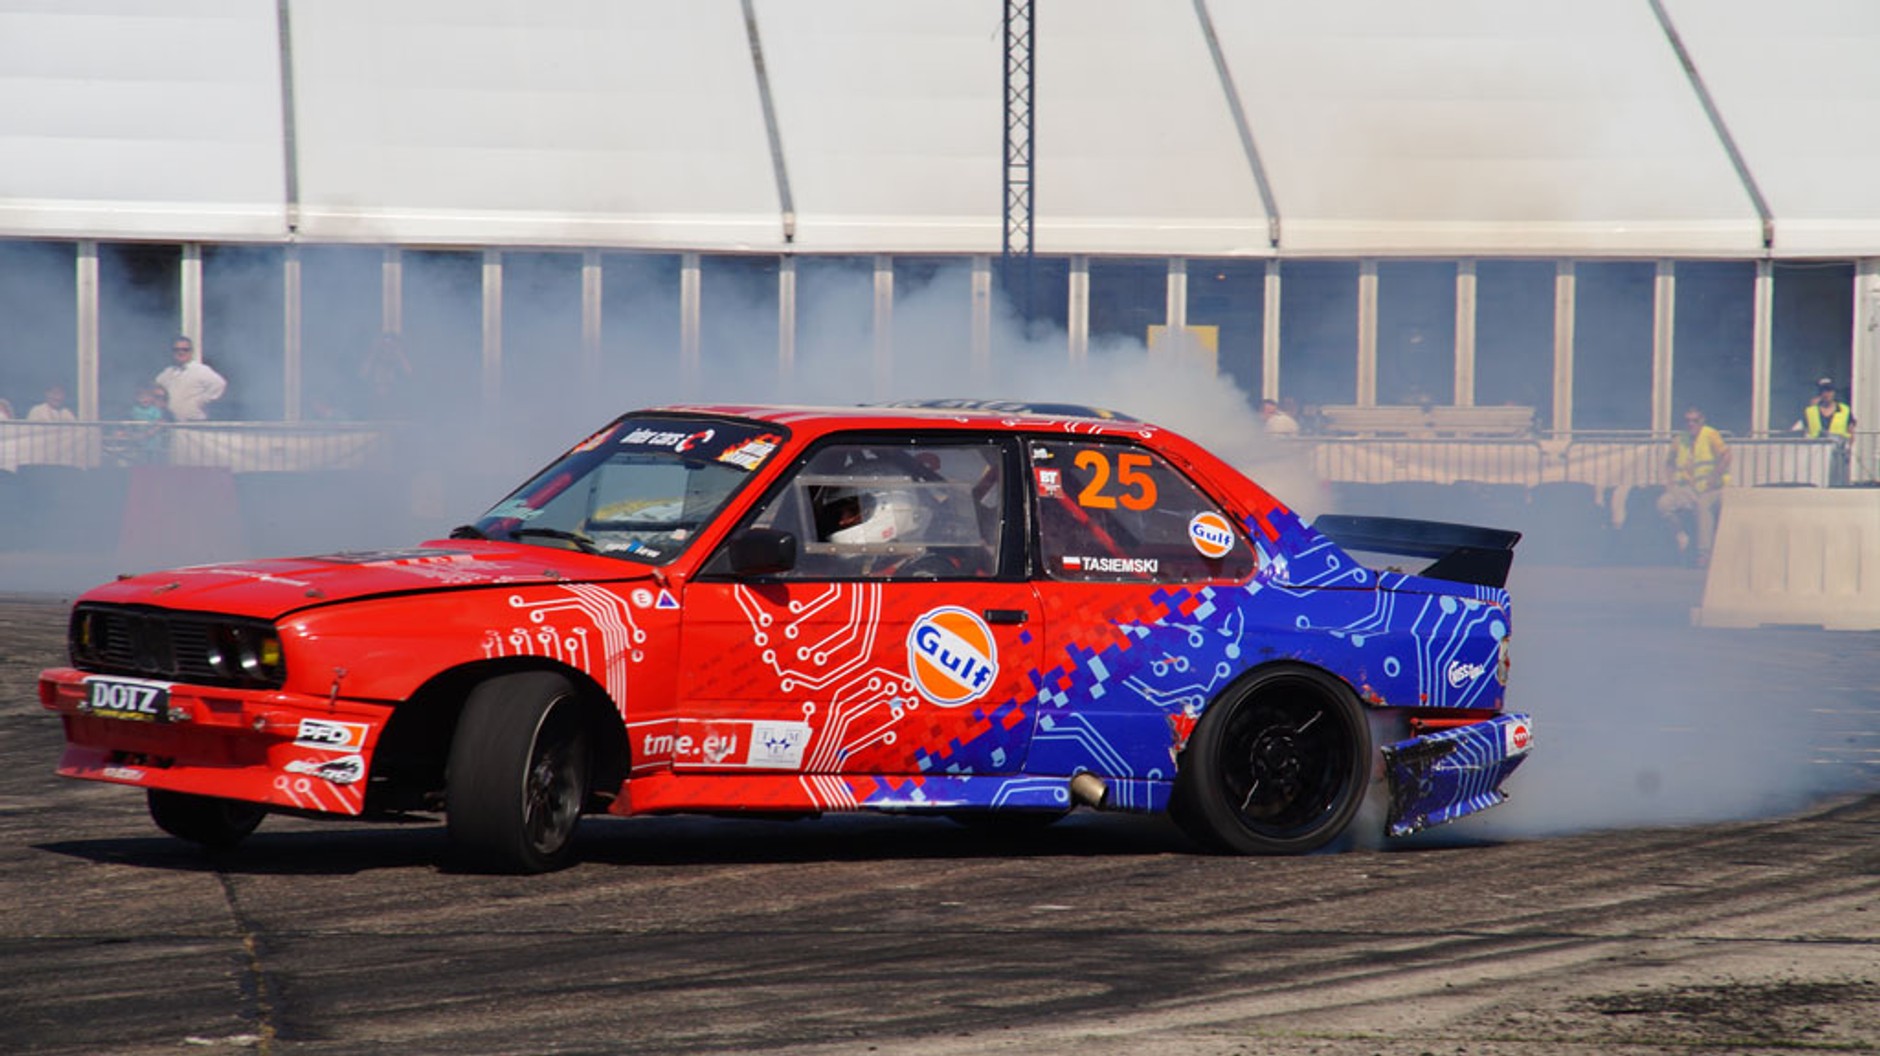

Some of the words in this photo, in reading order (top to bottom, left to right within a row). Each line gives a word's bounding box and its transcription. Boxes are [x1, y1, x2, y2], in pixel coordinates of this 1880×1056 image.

[1073, 449, 1158, 511] 25
[1193, 523, 1230, 546] Gulf
[1082, 556, 1159, 573] TASIEMSKI
[916, 624, 991, 688] Gulf
[92, 682, 160, 714] DOTZ
[643, 733, 738, 756] tme.eu
